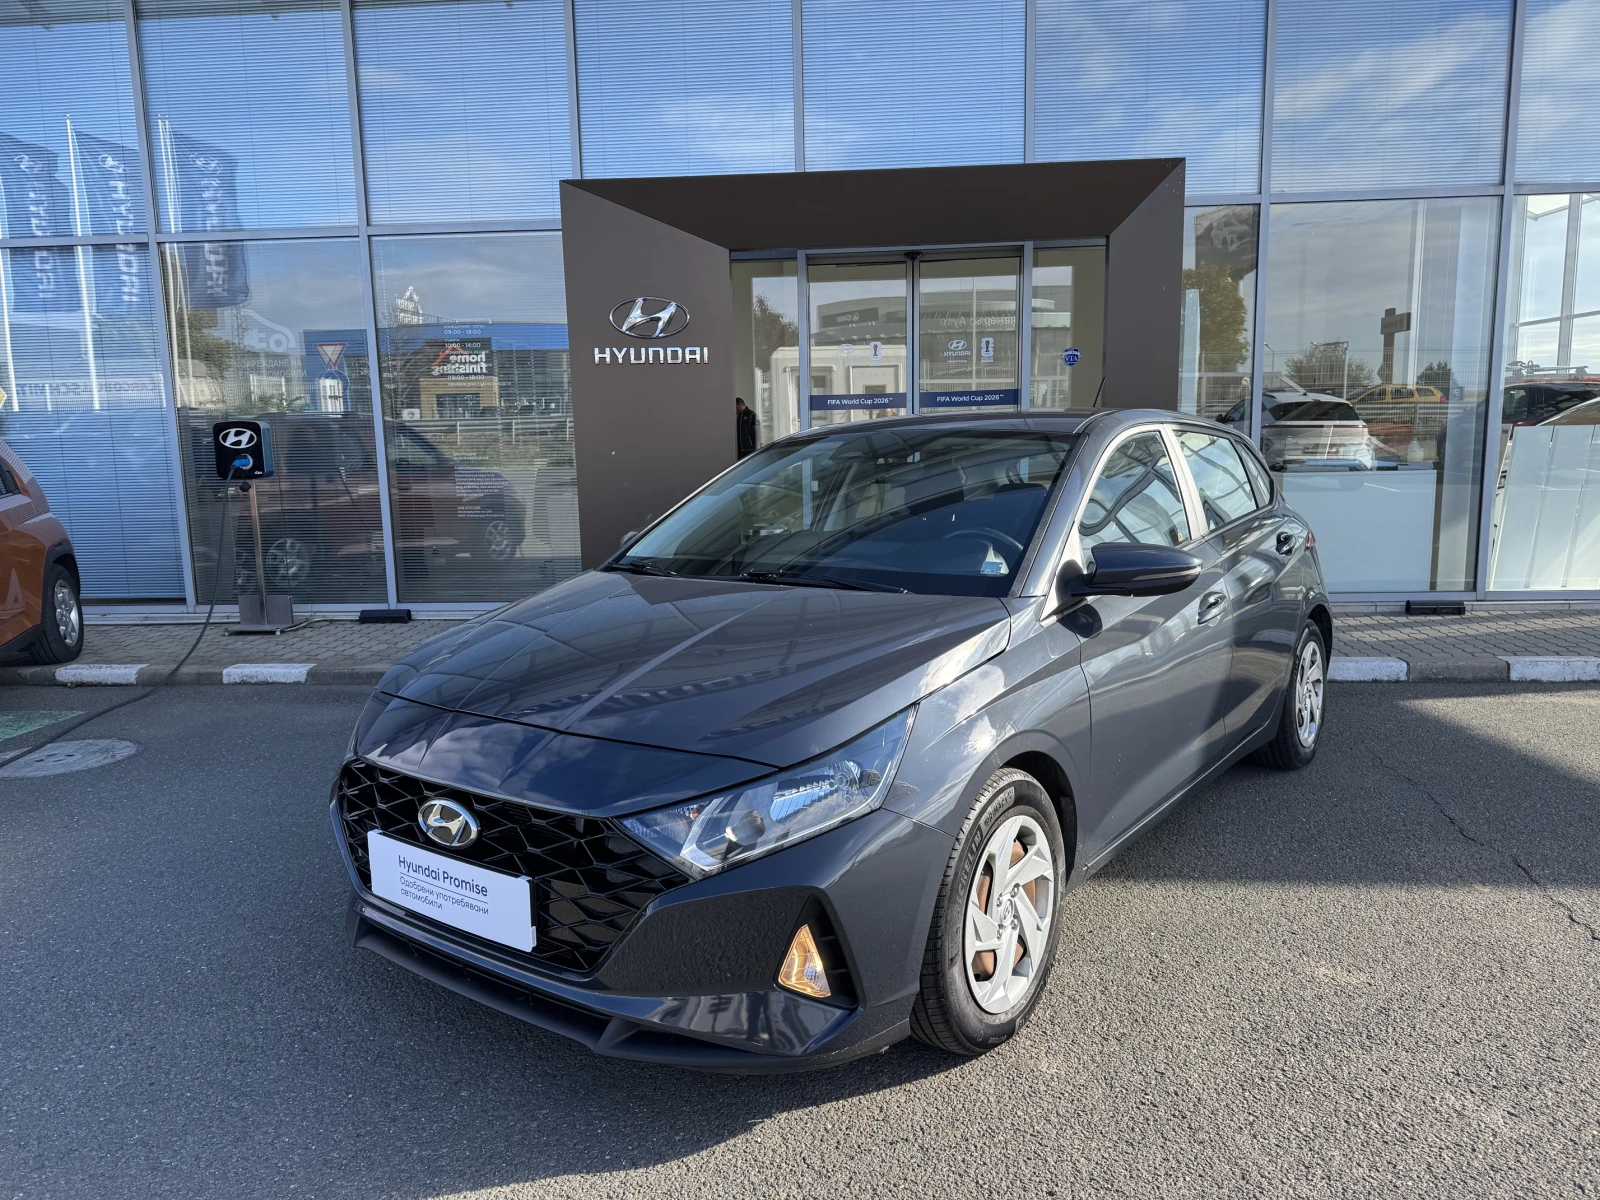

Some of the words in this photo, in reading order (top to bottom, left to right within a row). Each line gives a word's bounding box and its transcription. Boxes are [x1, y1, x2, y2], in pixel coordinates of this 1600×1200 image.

[291, 359, 302, 367] НА
[594, 347, 709, 365] HYUNDAI
[399, 855, 440, 882] Hyundai
[442, 871, 488, 897] Promise
[400, 876, 435, 896] Одобрени
[435, 890, 489, 915] употребявани
